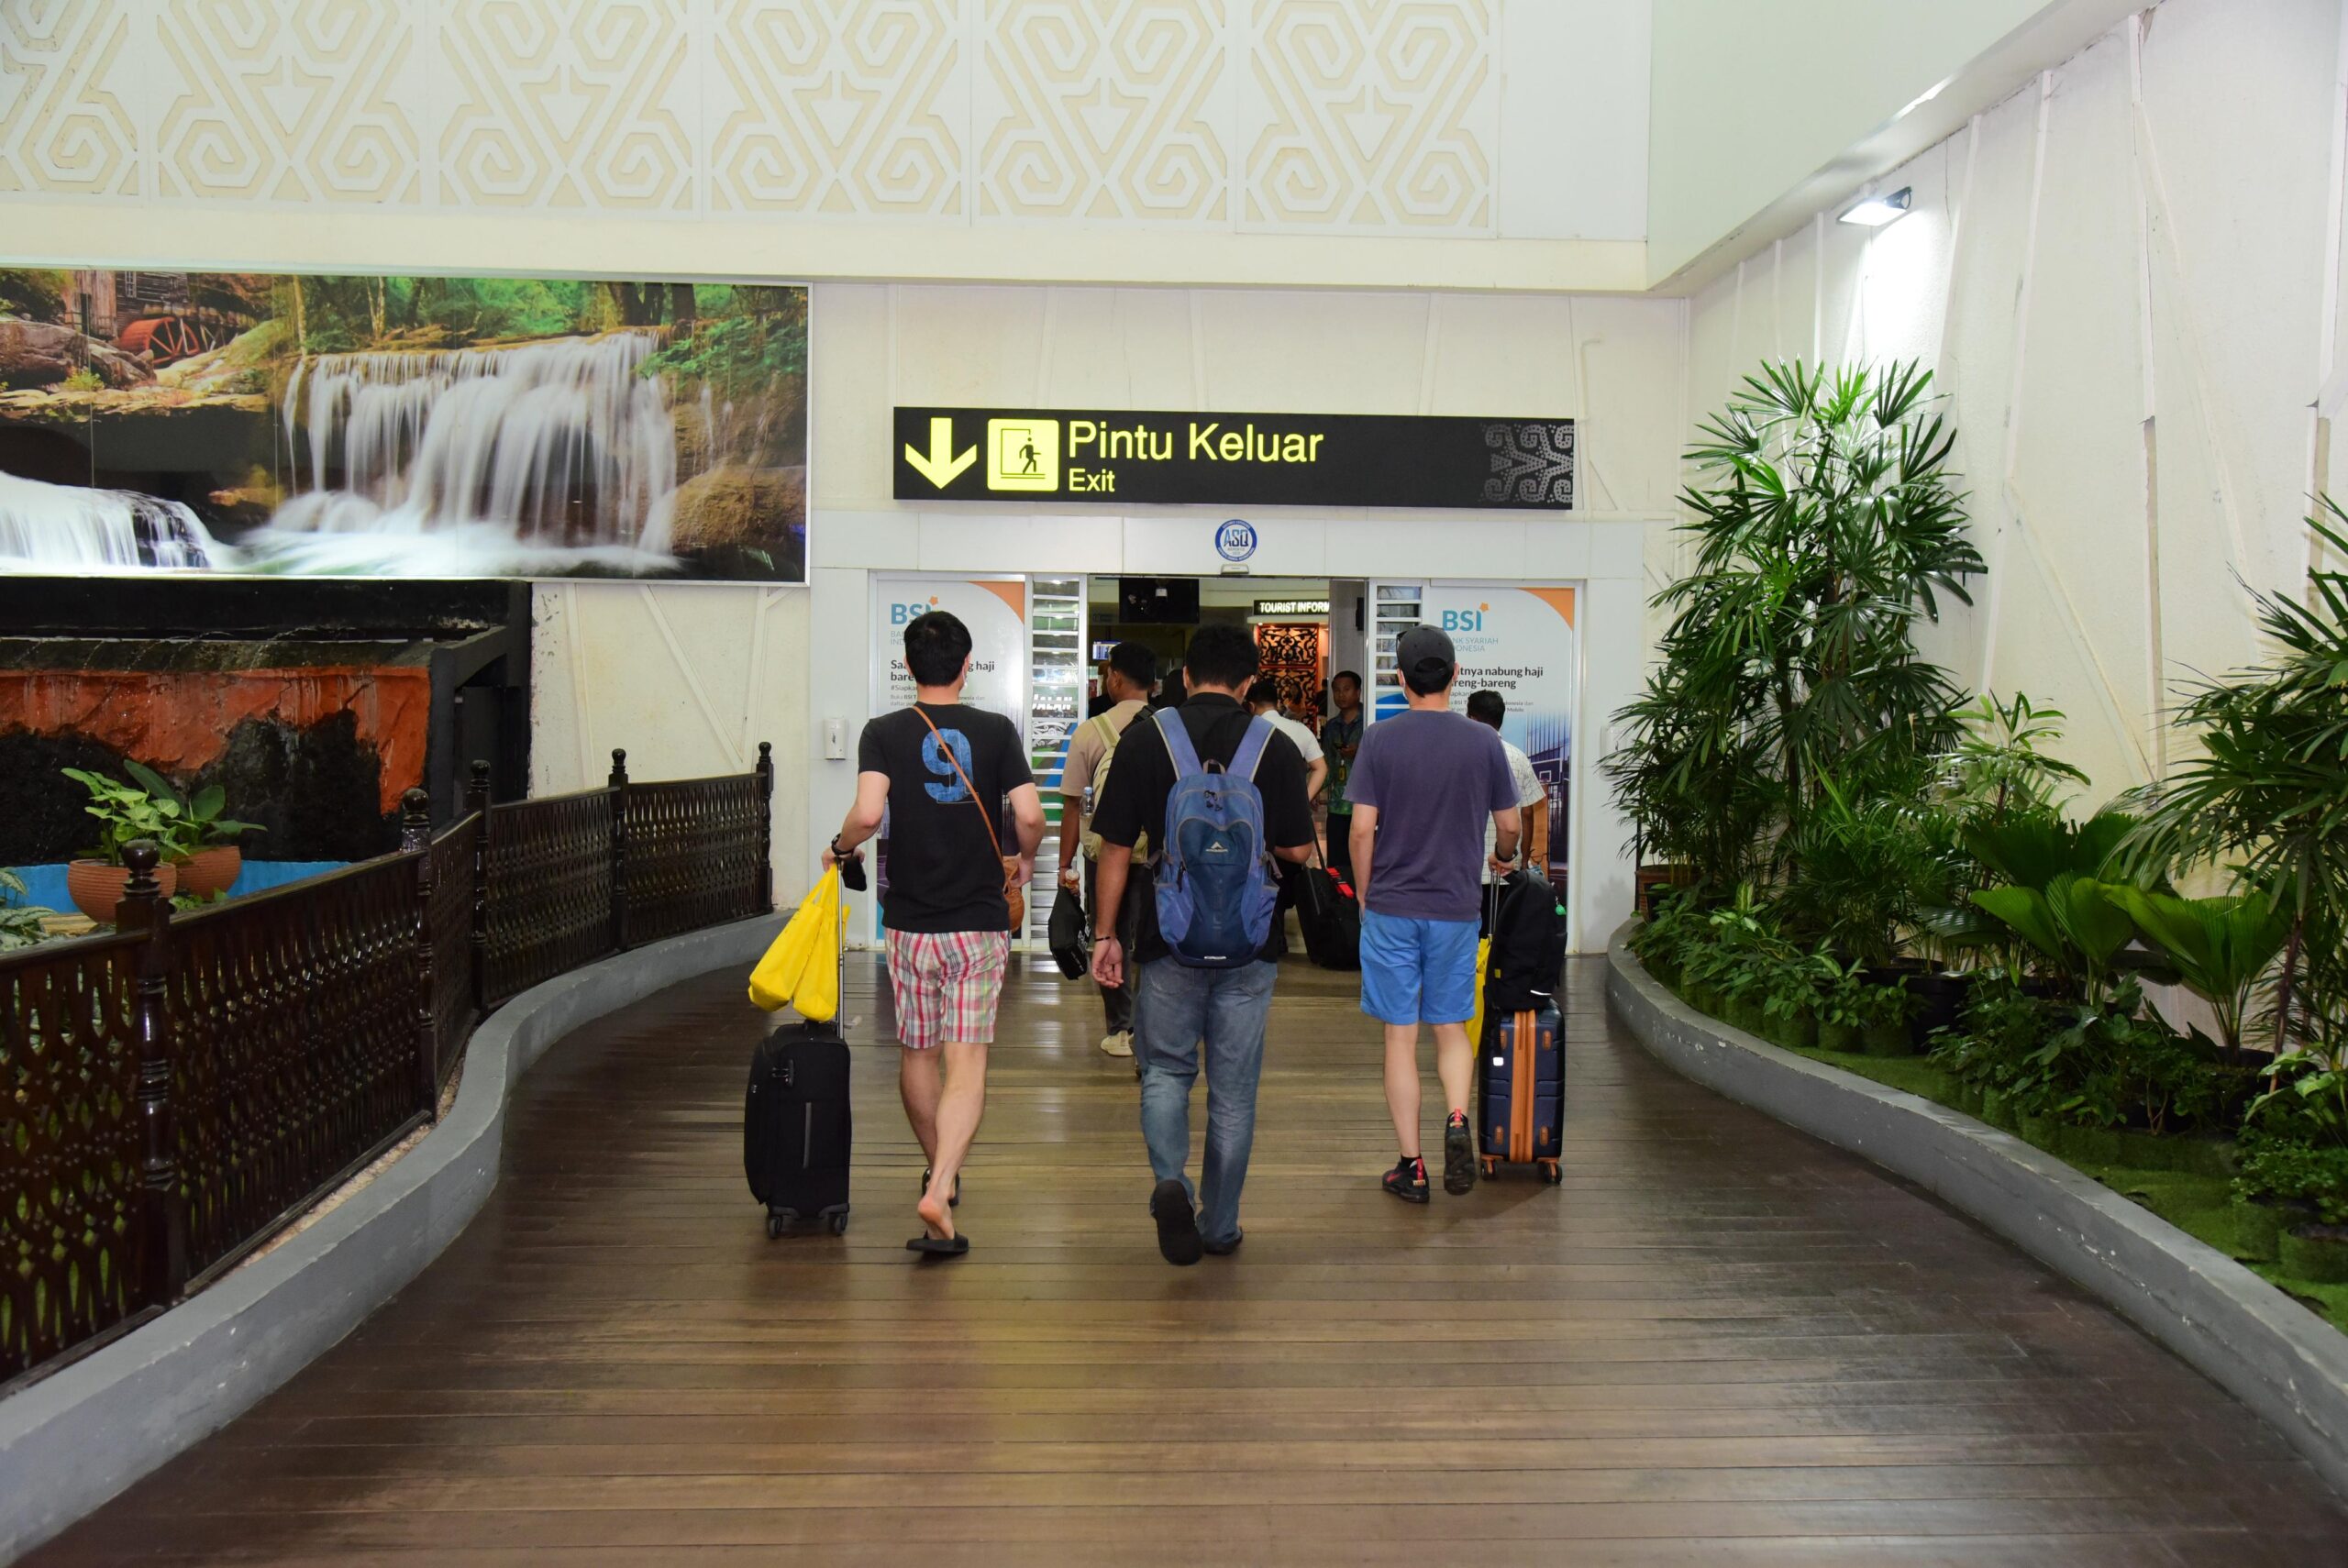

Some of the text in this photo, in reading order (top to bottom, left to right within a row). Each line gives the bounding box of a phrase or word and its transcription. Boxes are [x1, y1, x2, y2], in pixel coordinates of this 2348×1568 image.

[1069, 420, 1324, 462] Pintu Keluar
[1069, 468, 1115, 491] Exit
[1224, 528, 1249, 547] ASQ
[1260, 602, 1296, 613] TOURIST
[1442, 610, 1481, 632] BSI
[976, 661, 995, 672] haji
[1457, 667, 1544, 678] tnya nabung haji
[1451, 679, 1516, 690] reng-bareng
[922, 728, 973, 802] 9
